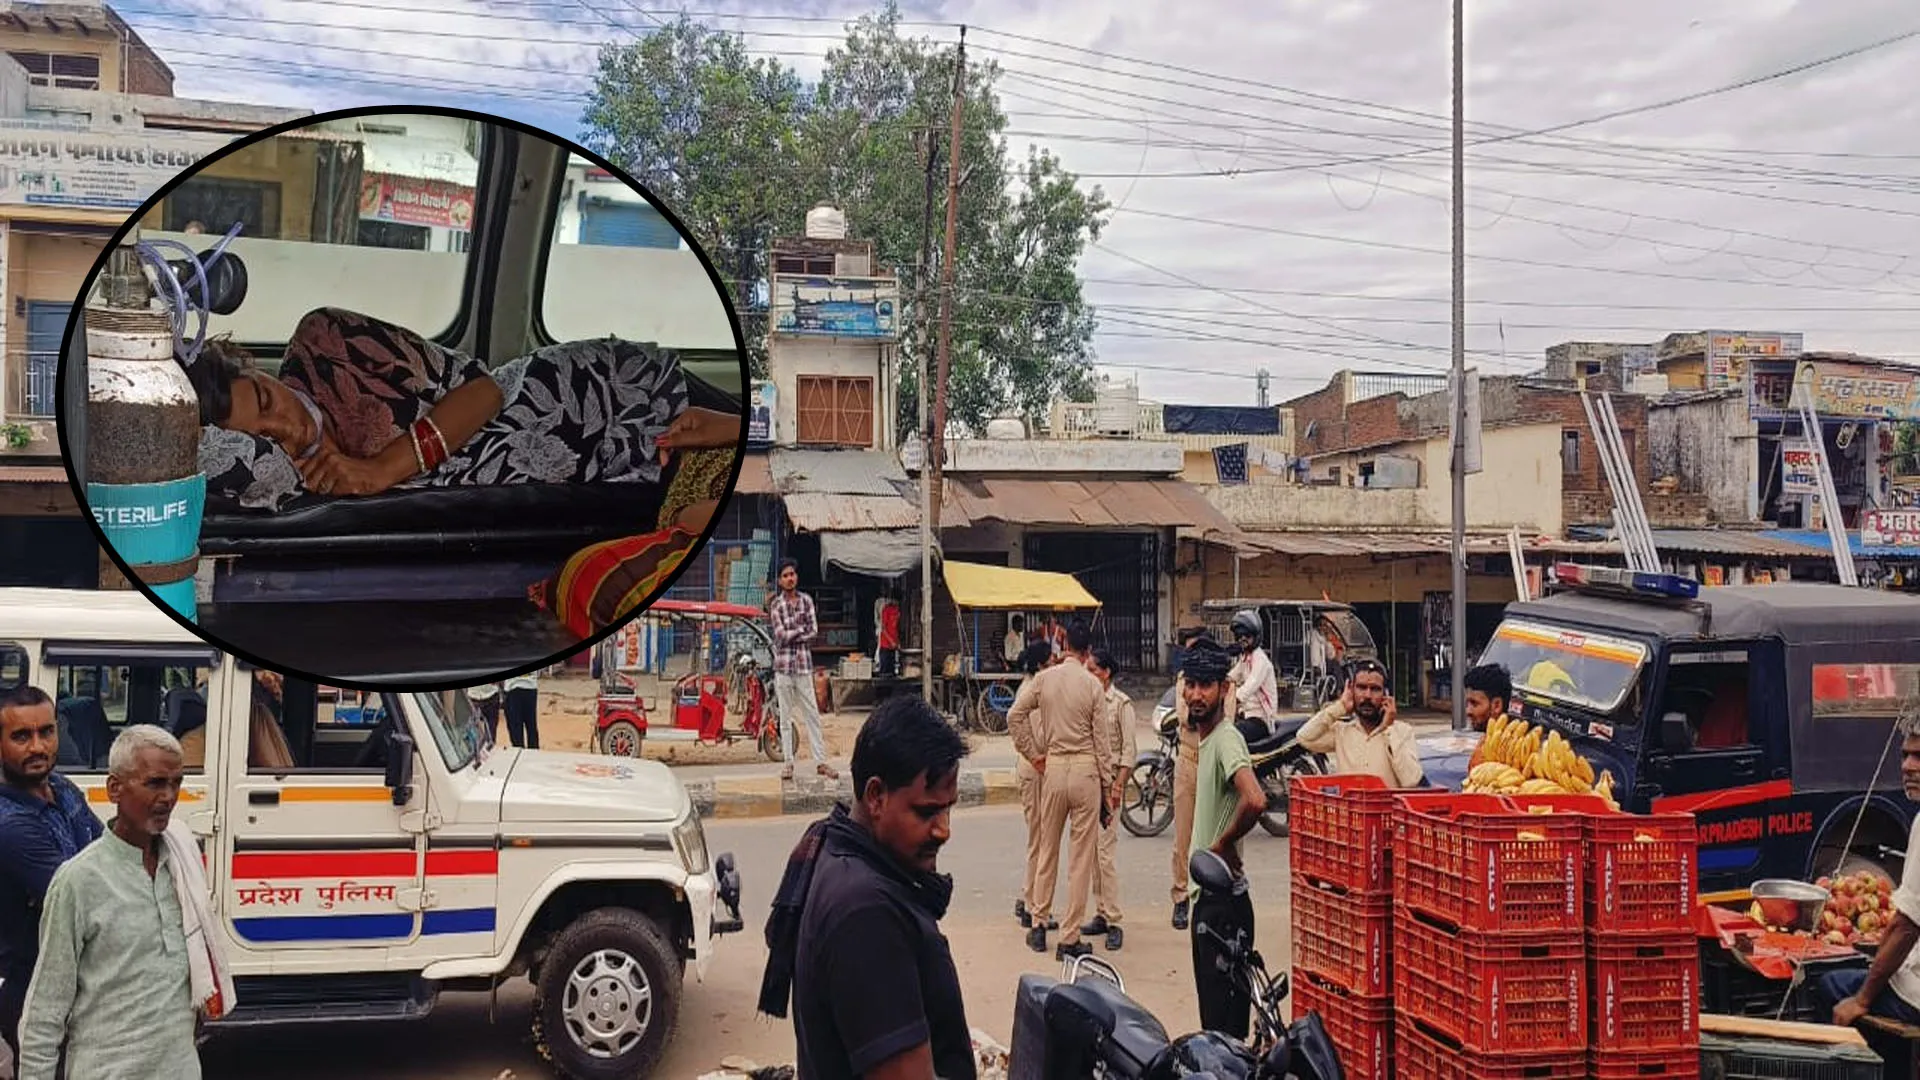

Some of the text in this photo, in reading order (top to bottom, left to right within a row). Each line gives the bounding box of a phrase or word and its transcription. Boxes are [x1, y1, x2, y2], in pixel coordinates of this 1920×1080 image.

[92, 499, 188, 525] STERILIFE
[1697, 811, 1813, 845] RPRADESH POLICE
[236, 881, 396, 910] प्रदेश पुलिस
[1488, 849, 1496, 913] AFC
[1604, 850, 1612, 913] AFC
[1491, 975, 1499, 1040] AFC
[1606, 974, 1614, 1038] AFC
